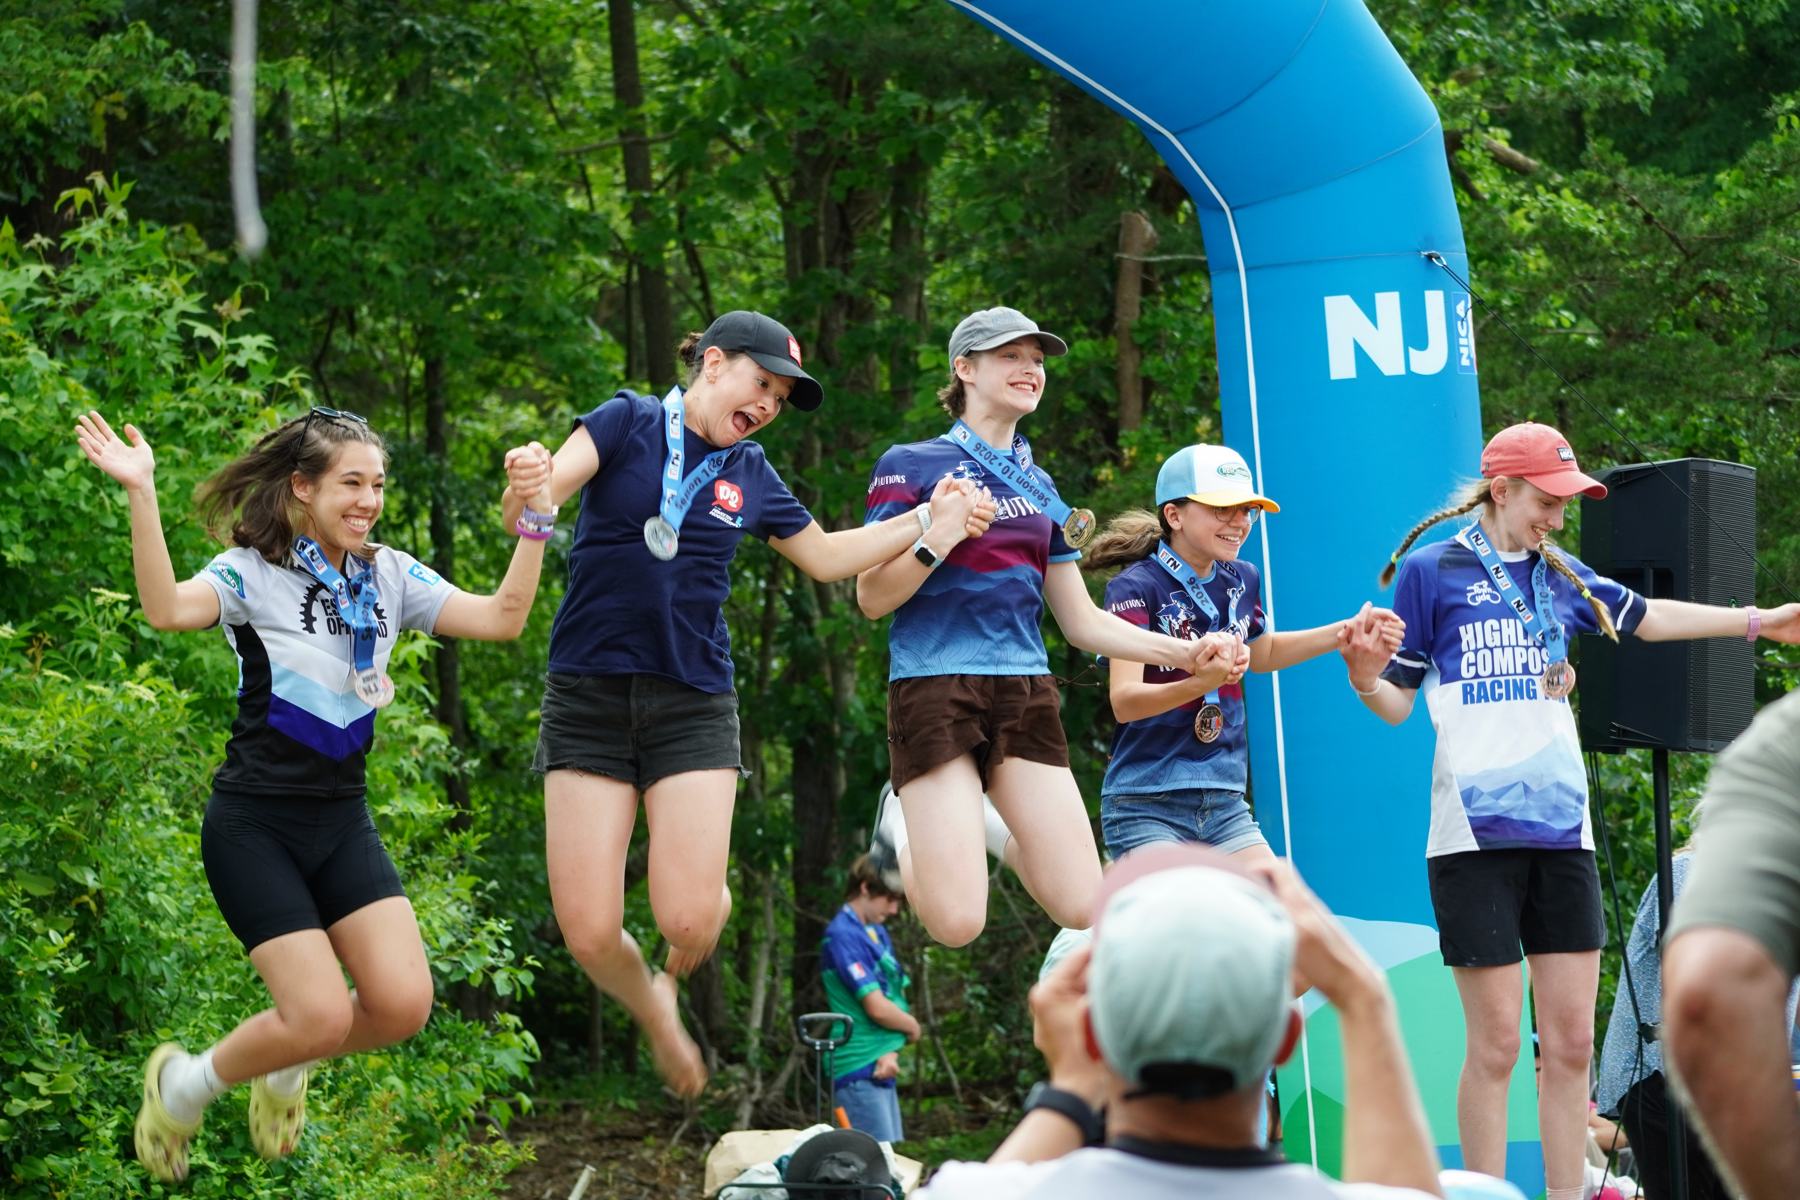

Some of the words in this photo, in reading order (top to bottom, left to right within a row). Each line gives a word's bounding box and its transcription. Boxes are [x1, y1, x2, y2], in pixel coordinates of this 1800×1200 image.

[1324, 290, 1448, 380] NJ
[1456, 300, 1471, 366] NICA
[972, 442, 999, 465] 2026
[1001, 465, 1016, 480] 10
[1016, 475, 1051, 508] Season
[1187, 576, 1209, 606] 2026
[1459, 619, 1542, 652] HIGHL
[1461, 646, 1552, 679] COMPOS
[1462, 678, 1538, 705] RACING
